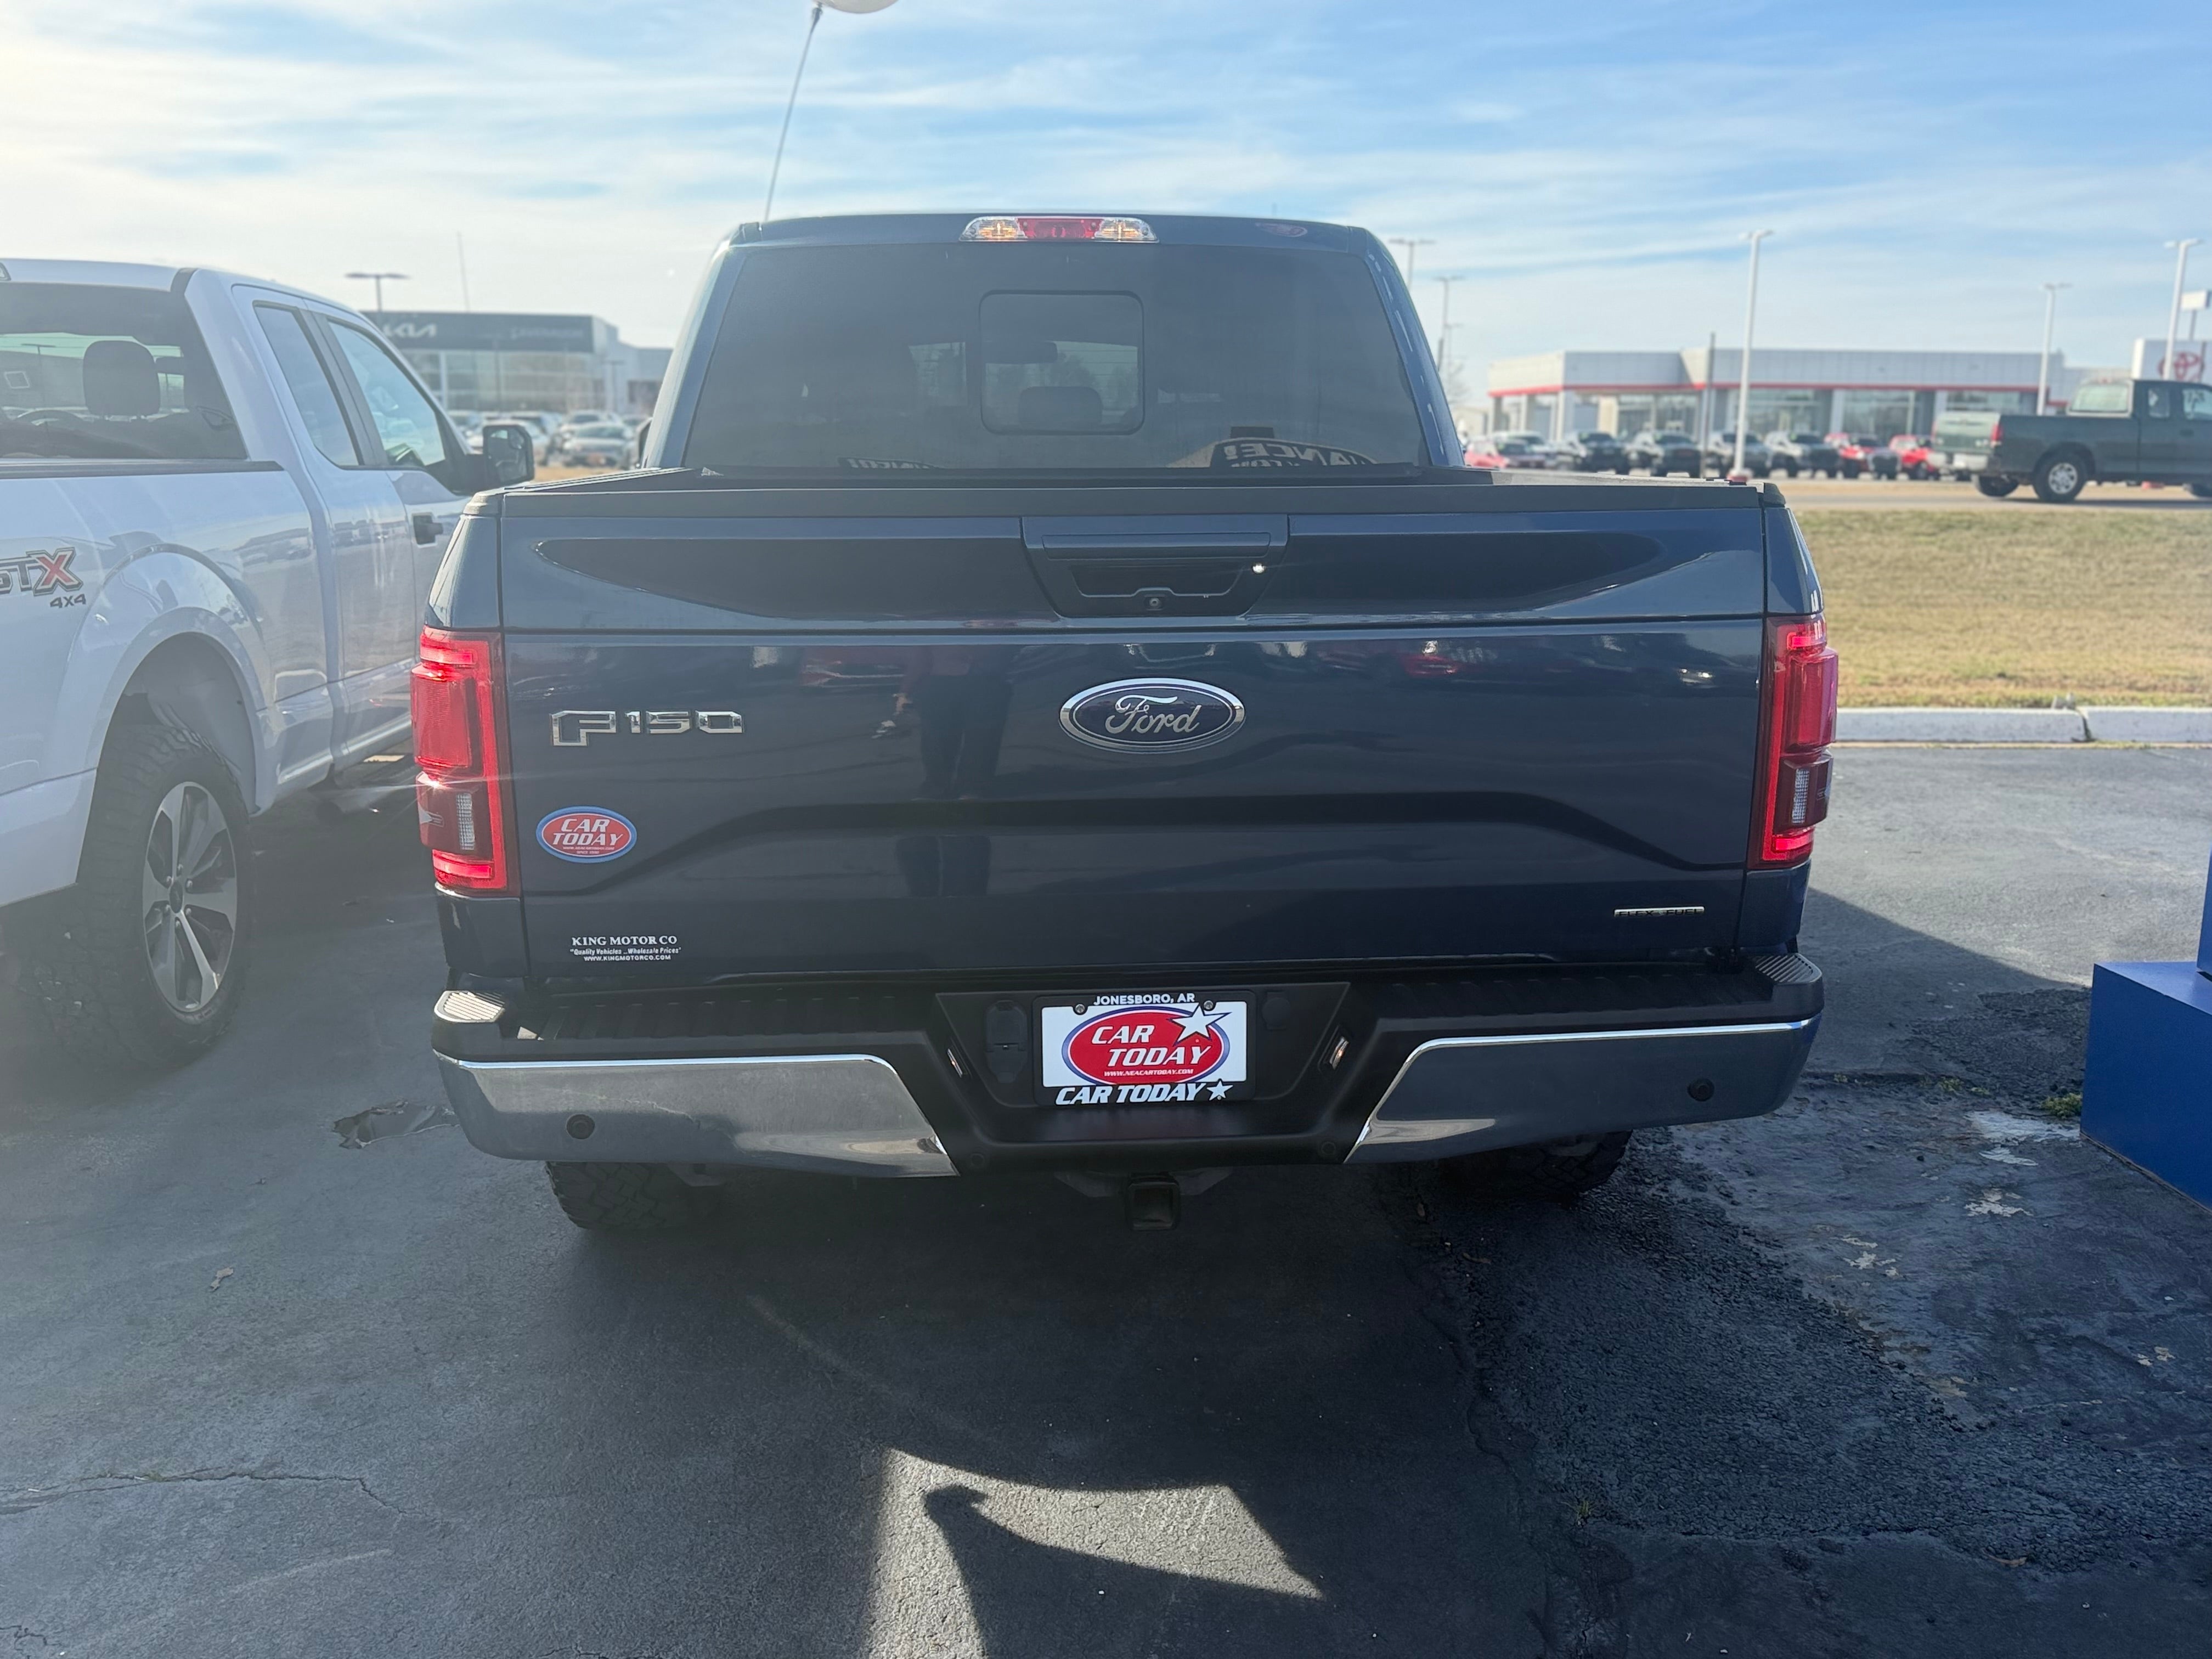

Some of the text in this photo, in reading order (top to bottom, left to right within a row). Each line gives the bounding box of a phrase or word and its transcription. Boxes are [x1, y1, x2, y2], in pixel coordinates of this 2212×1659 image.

[1105, 695, 1202, 733] Ford
[561, 818, 611, 833] CAR
[552, 833, 623, 846] TODAY
[572, 935, 678, 946] KING MOTOR CO
[1093, 993, 1195, 1006] JONESBORO, AR
[1091, 1024, 1155, 1045] CAR
[1107, 1046, 1211, 1066] TODAY
[1103, 1069, 1194, 1077] WWW.NEACARTODAY.COM
[1056, 1083, 1206, 1105] CAR TODAY
